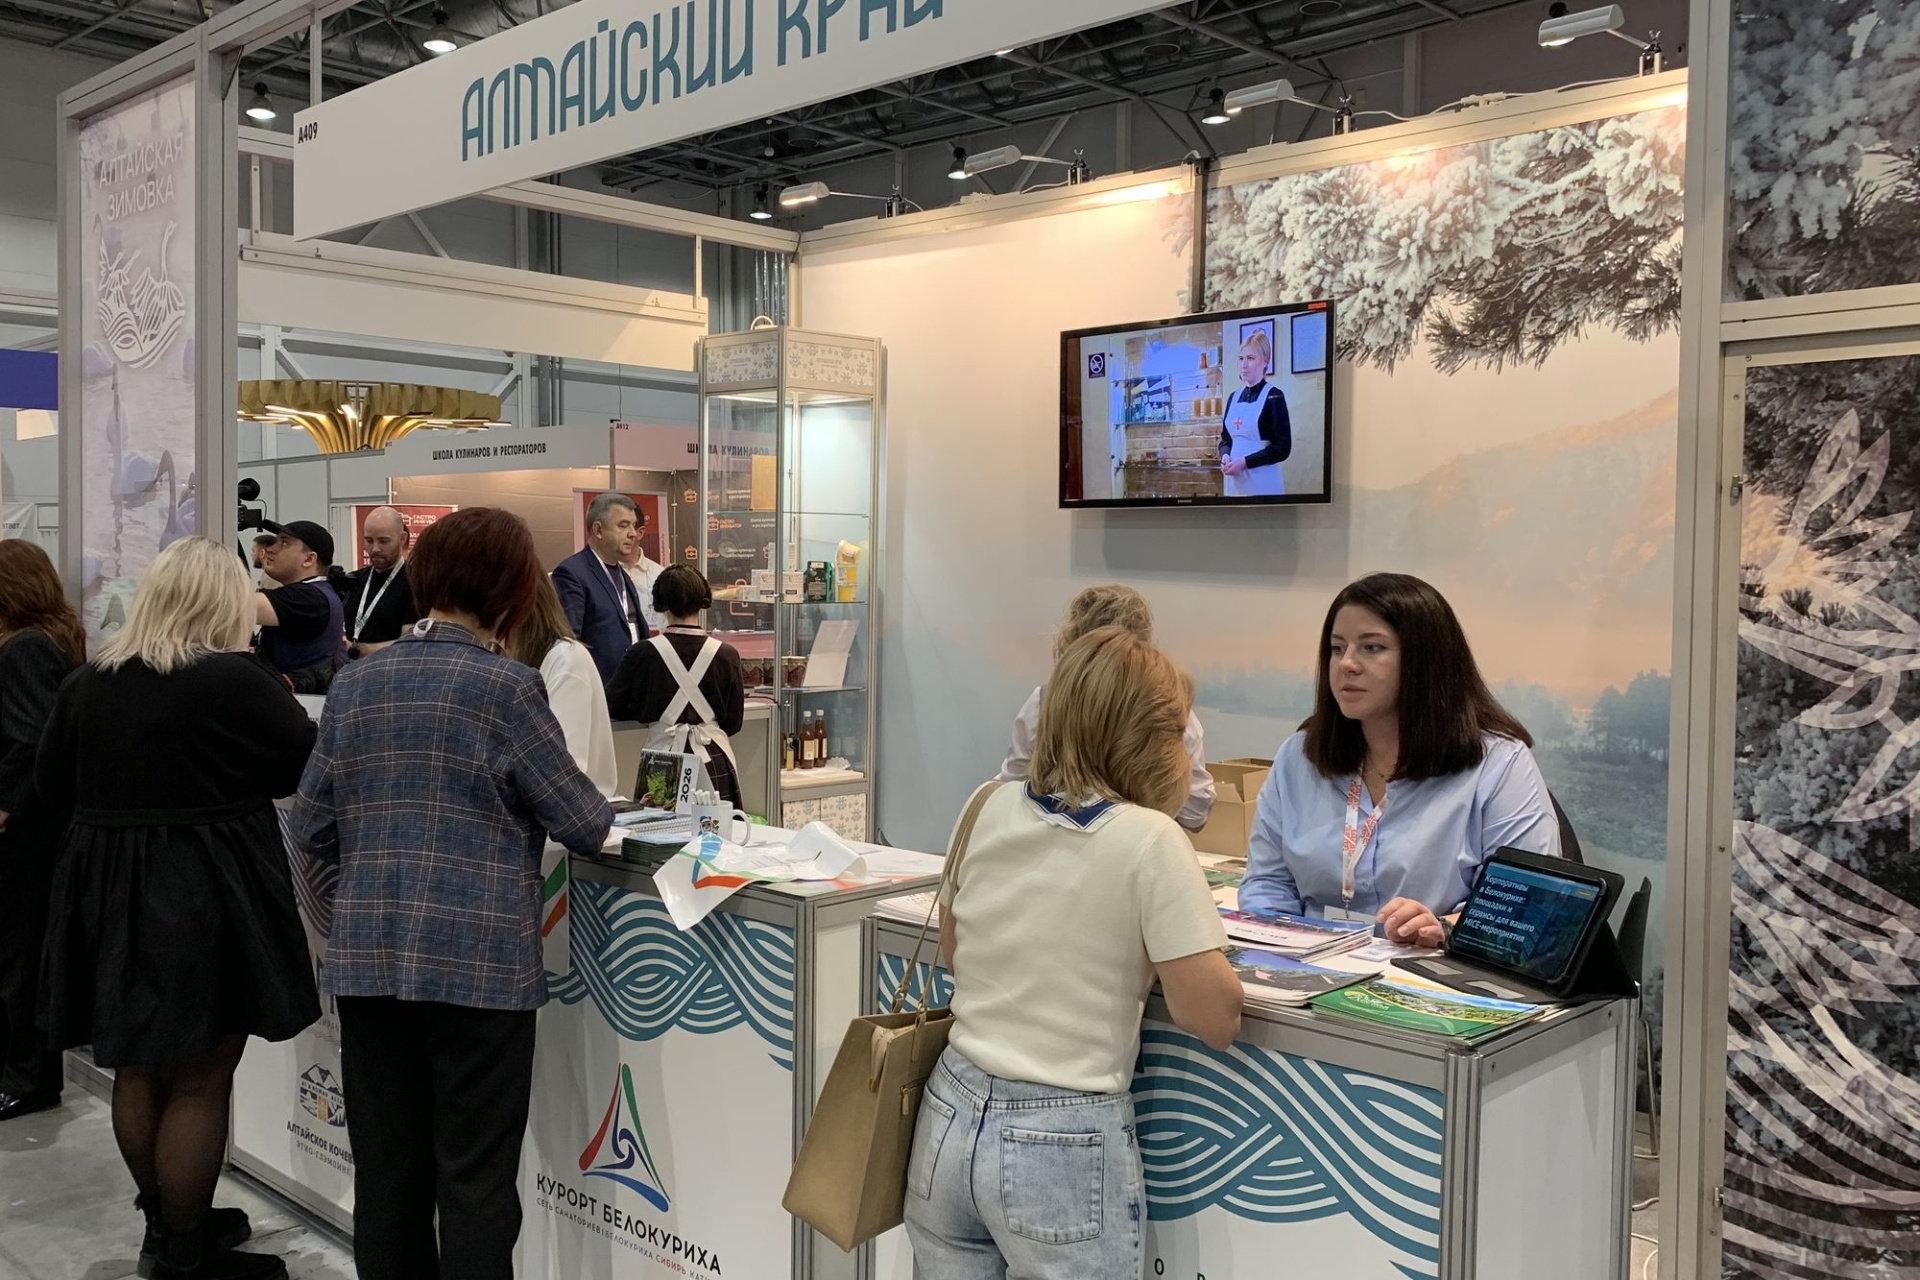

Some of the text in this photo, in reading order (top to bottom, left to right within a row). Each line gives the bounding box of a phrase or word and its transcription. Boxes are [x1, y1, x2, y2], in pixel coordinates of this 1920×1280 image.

[777, 0, 943, 66] КР
[298, 121, 318, 144] A409
[100, 132, 184, 187] АЛТАЙСКАЯ
[107, 174, 175, 222] ЗИМОВКА
[432, 442, 547, 461] ШКОЛА КУЛИНАРОВ И РЕСТОРАТОРОВ
[687, 442, 718, 455] ШЛА
[680, 767, 692, 803] 2026
[1484, 873, 1530, 892] Корпоративы
[1474, 897, 1506, 911] площадки
[1468, 908, 1535, 932] сервисы для вашего
[287, 1120, 327, 1151] АЛТАЙСКОЕ
[536, 1173, 722, 1275] КУРОРТ БЕЛОКУРИХА
[536, 1197, 554, 1211] СЕТЬ
[555, 1206, 600, 1234] САНАТОРИЕВ
[605, 1230, 654, 1259] БЕЛОКУРИХА
[655, 1254, 687, 1275] СИБИРЬ
